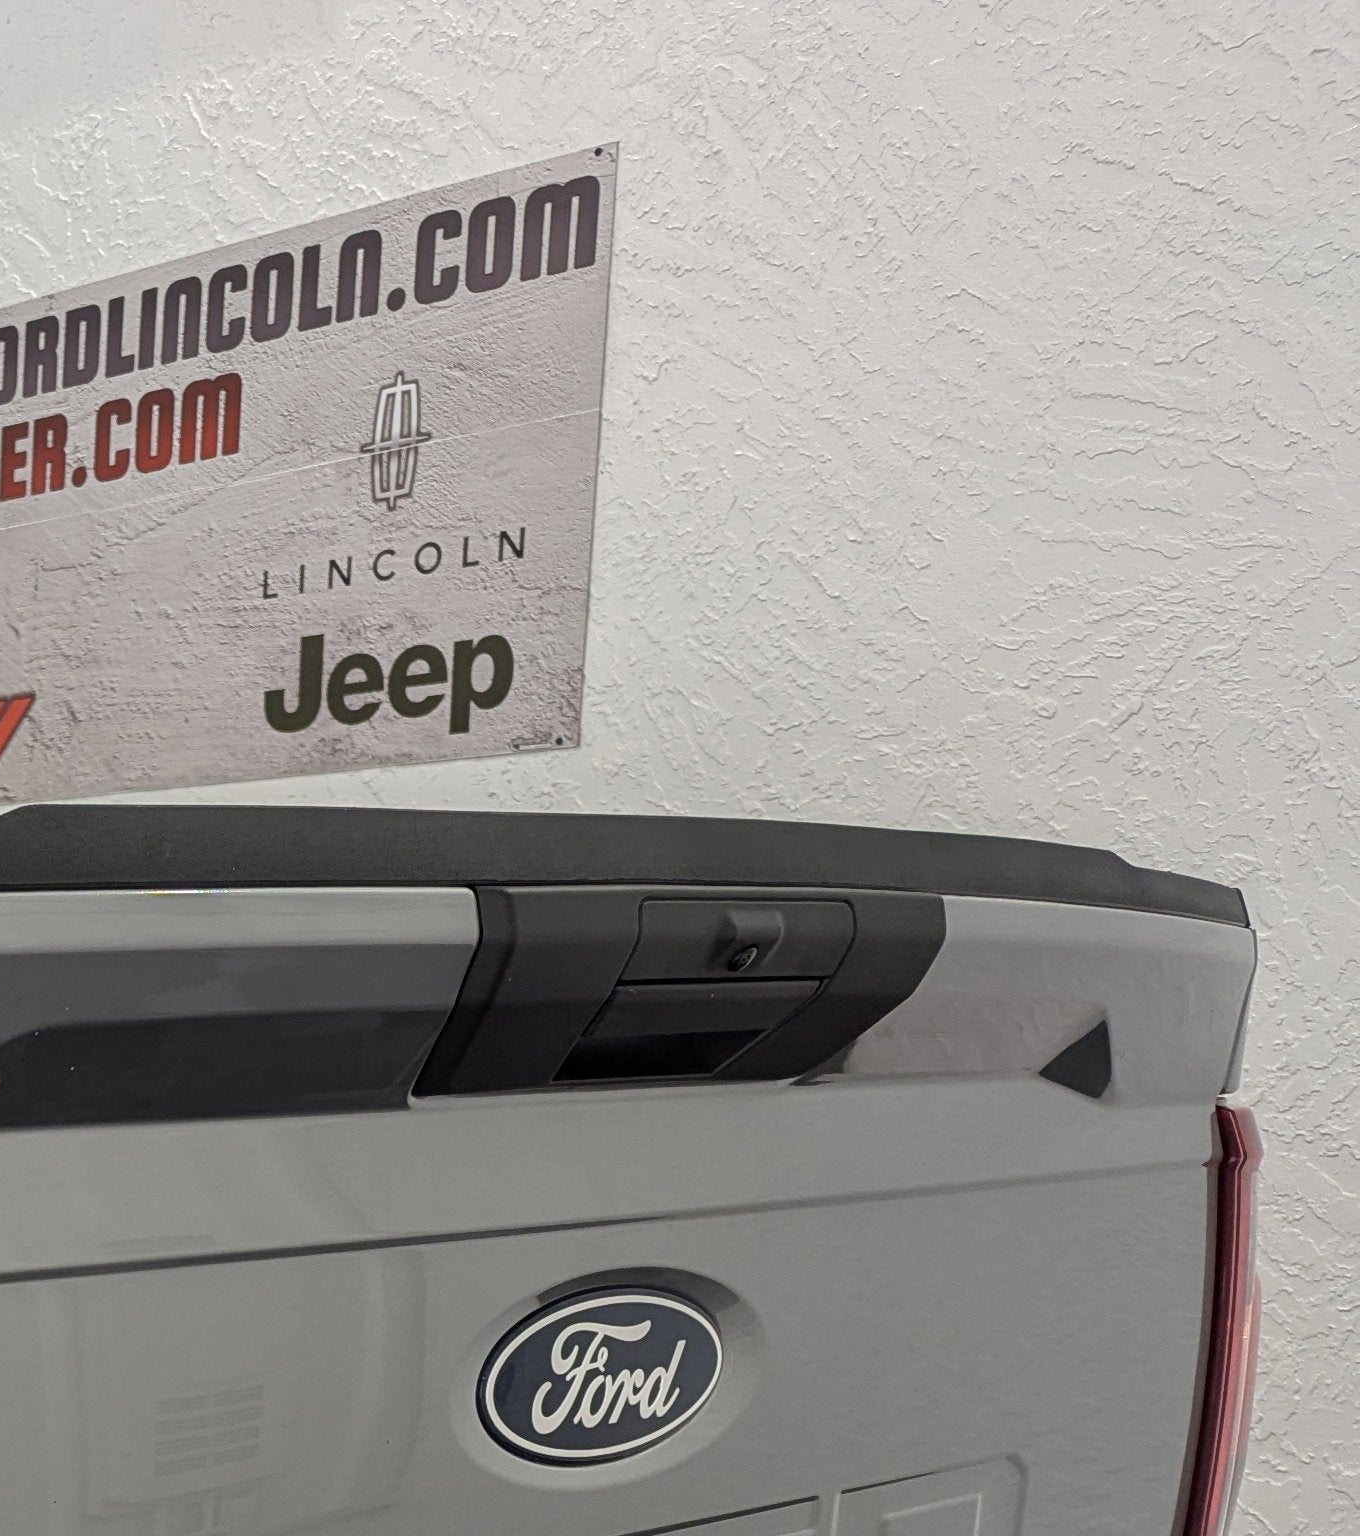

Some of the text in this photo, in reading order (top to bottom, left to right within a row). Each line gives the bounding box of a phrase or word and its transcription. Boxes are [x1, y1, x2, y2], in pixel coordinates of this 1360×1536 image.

[261, 527, 527, 599] LINCOLN
[264, 634, 514, 734] Jeep
[530, 1318, 687, 1435] Ford
